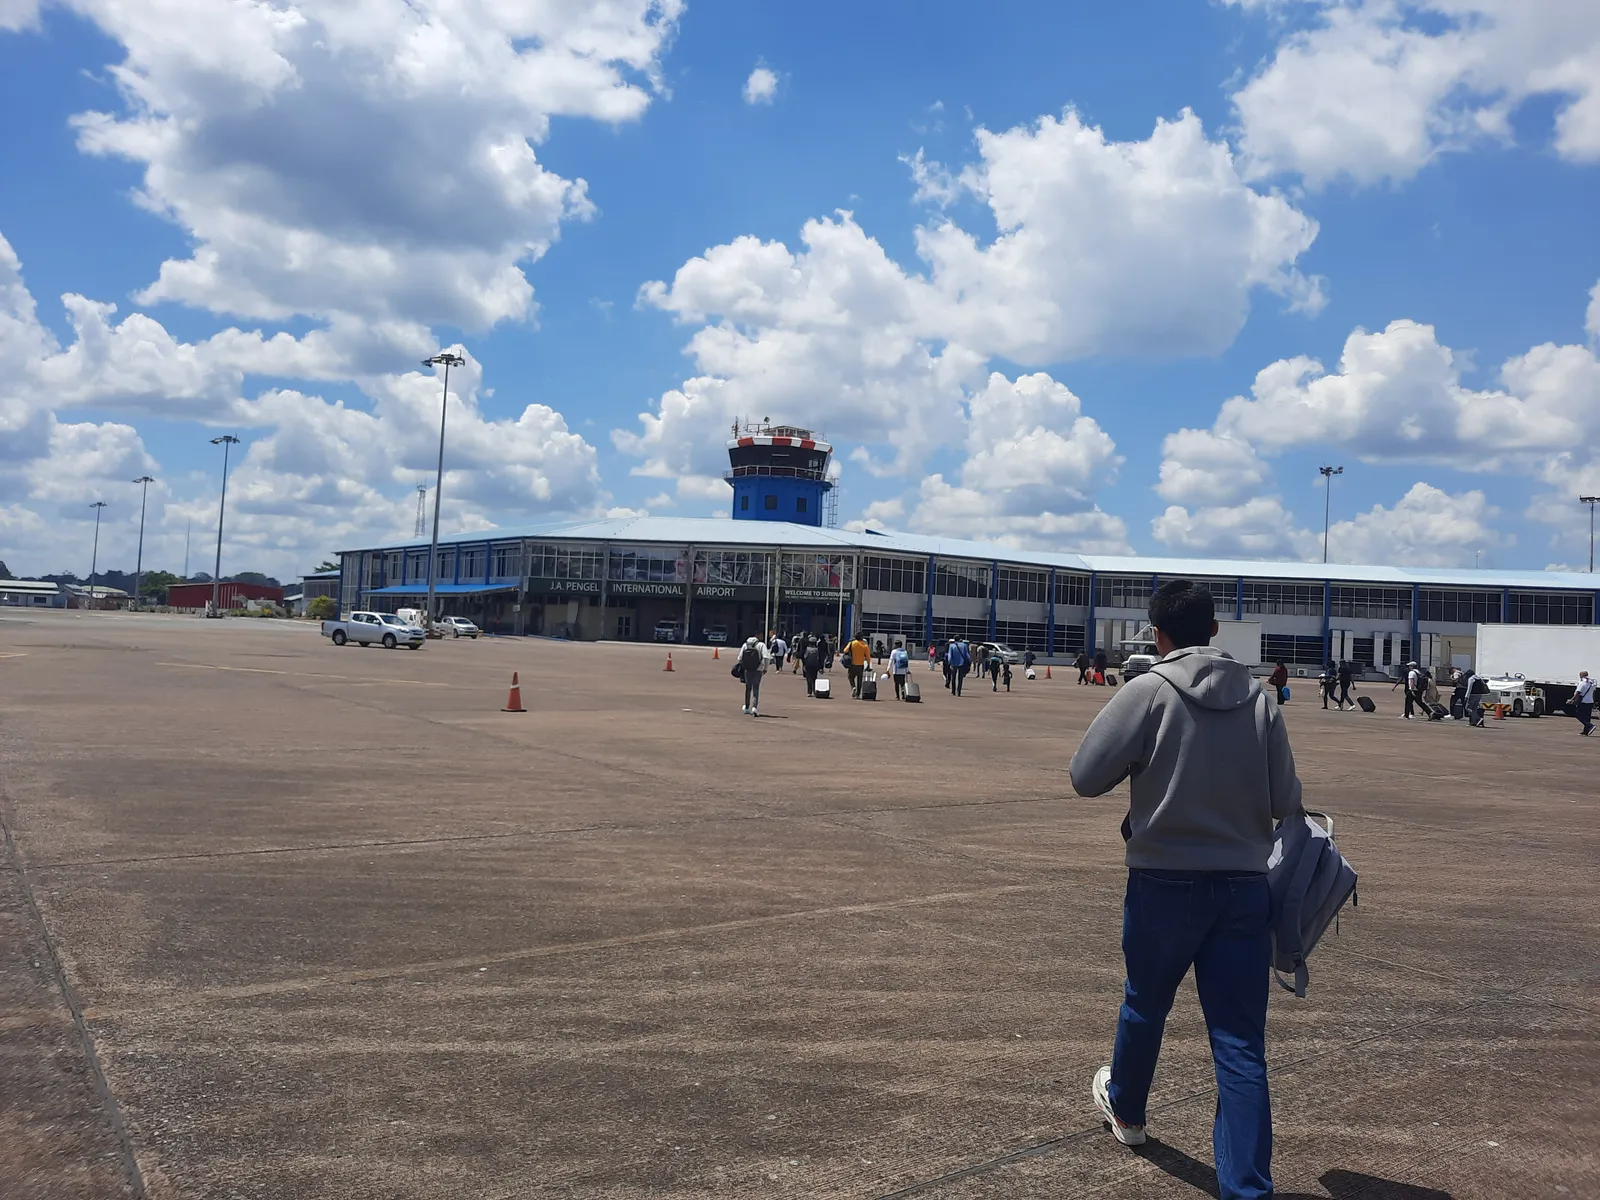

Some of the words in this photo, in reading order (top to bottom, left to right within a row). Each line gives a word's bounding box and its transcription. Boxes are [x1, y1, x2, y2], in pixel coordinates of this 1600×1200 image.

[550, 581, 565, 591] J.A.
[566, 581, 600, 592] PENGEL
[613, 583, 683, 595] INTERNATIONAL
[697, 586, 736, 597] AIRPORT
